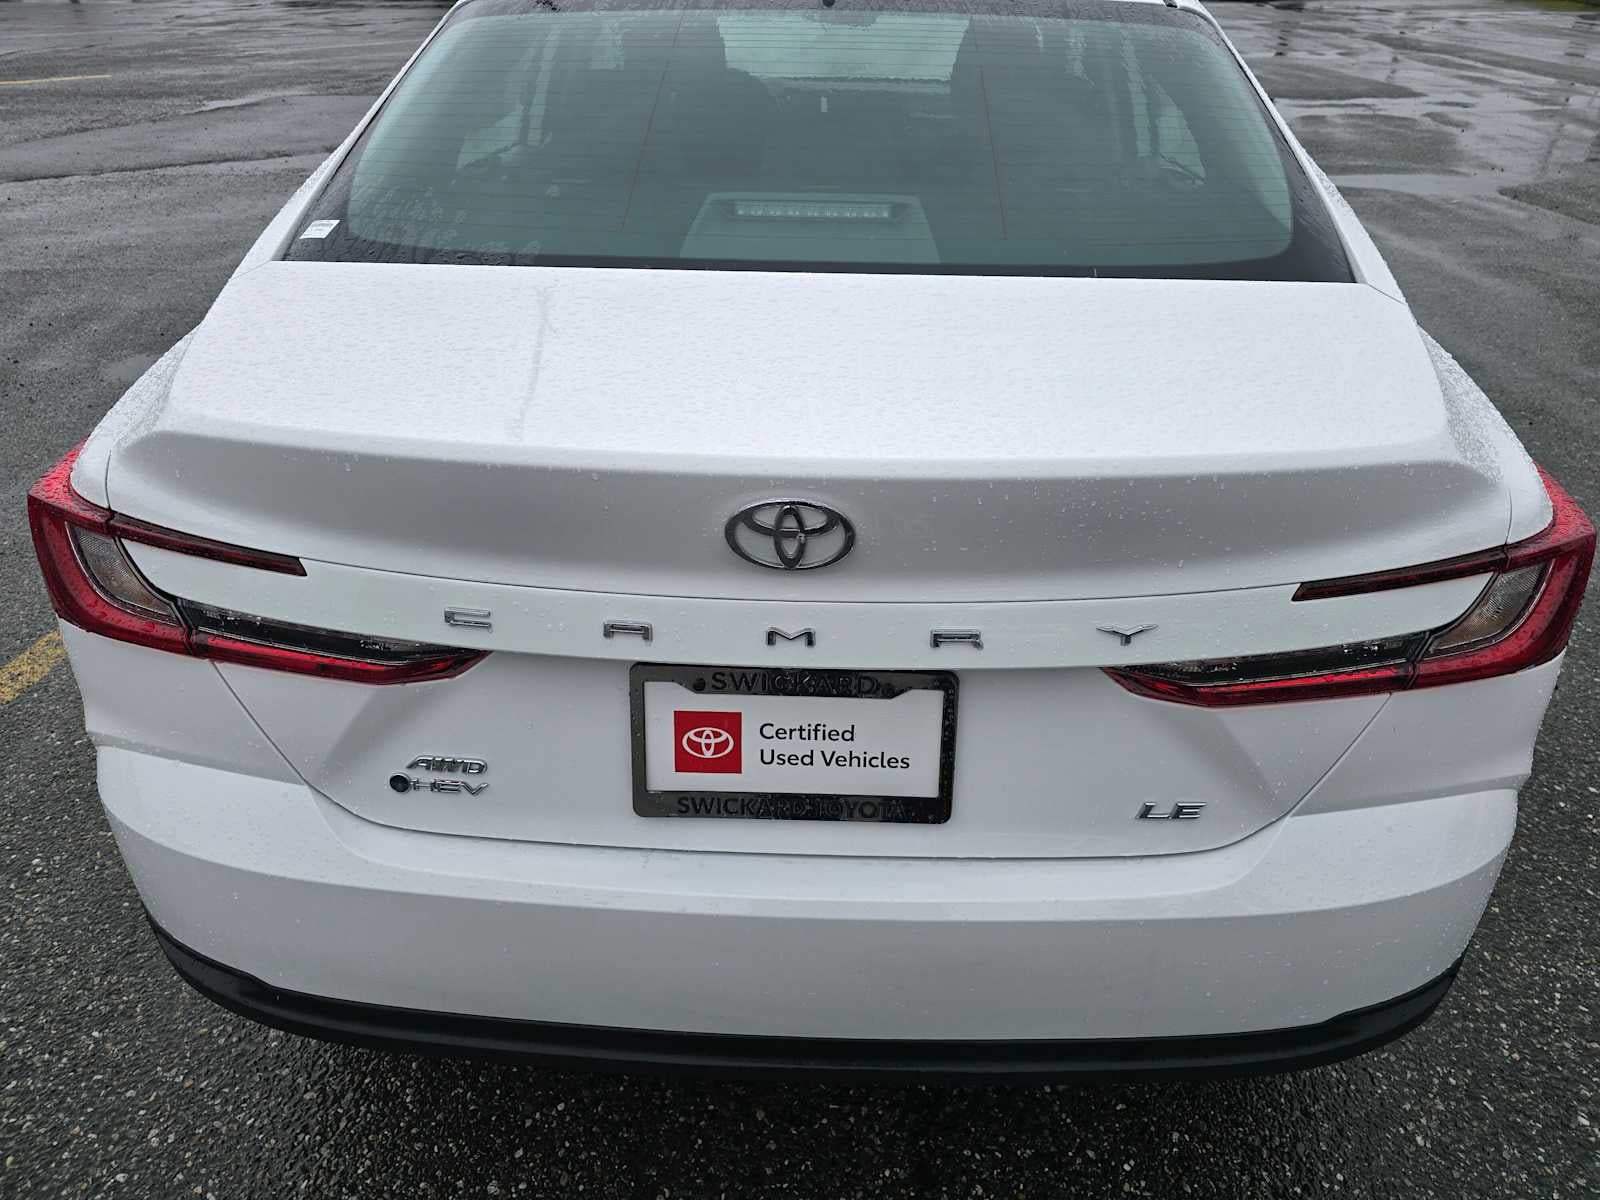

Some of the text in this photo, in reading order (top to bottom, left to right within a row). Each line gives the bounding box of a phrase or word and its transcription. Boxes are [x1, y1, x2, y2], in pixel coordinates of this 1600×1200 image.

[444, 606, 1159, 650] CAMRY
[711, 671, 879, 695] SWICKARD
[759, 722, 855, 742] Certified
[406, 755, 488, 775] AWD
[760, 749, 910, 769] Used Vehicles
[410, 779, 489, 796] HEV
[677, 795, 907, 819] SWICKARD TOYOTA
[1135, 801, 1207, 820] LE
